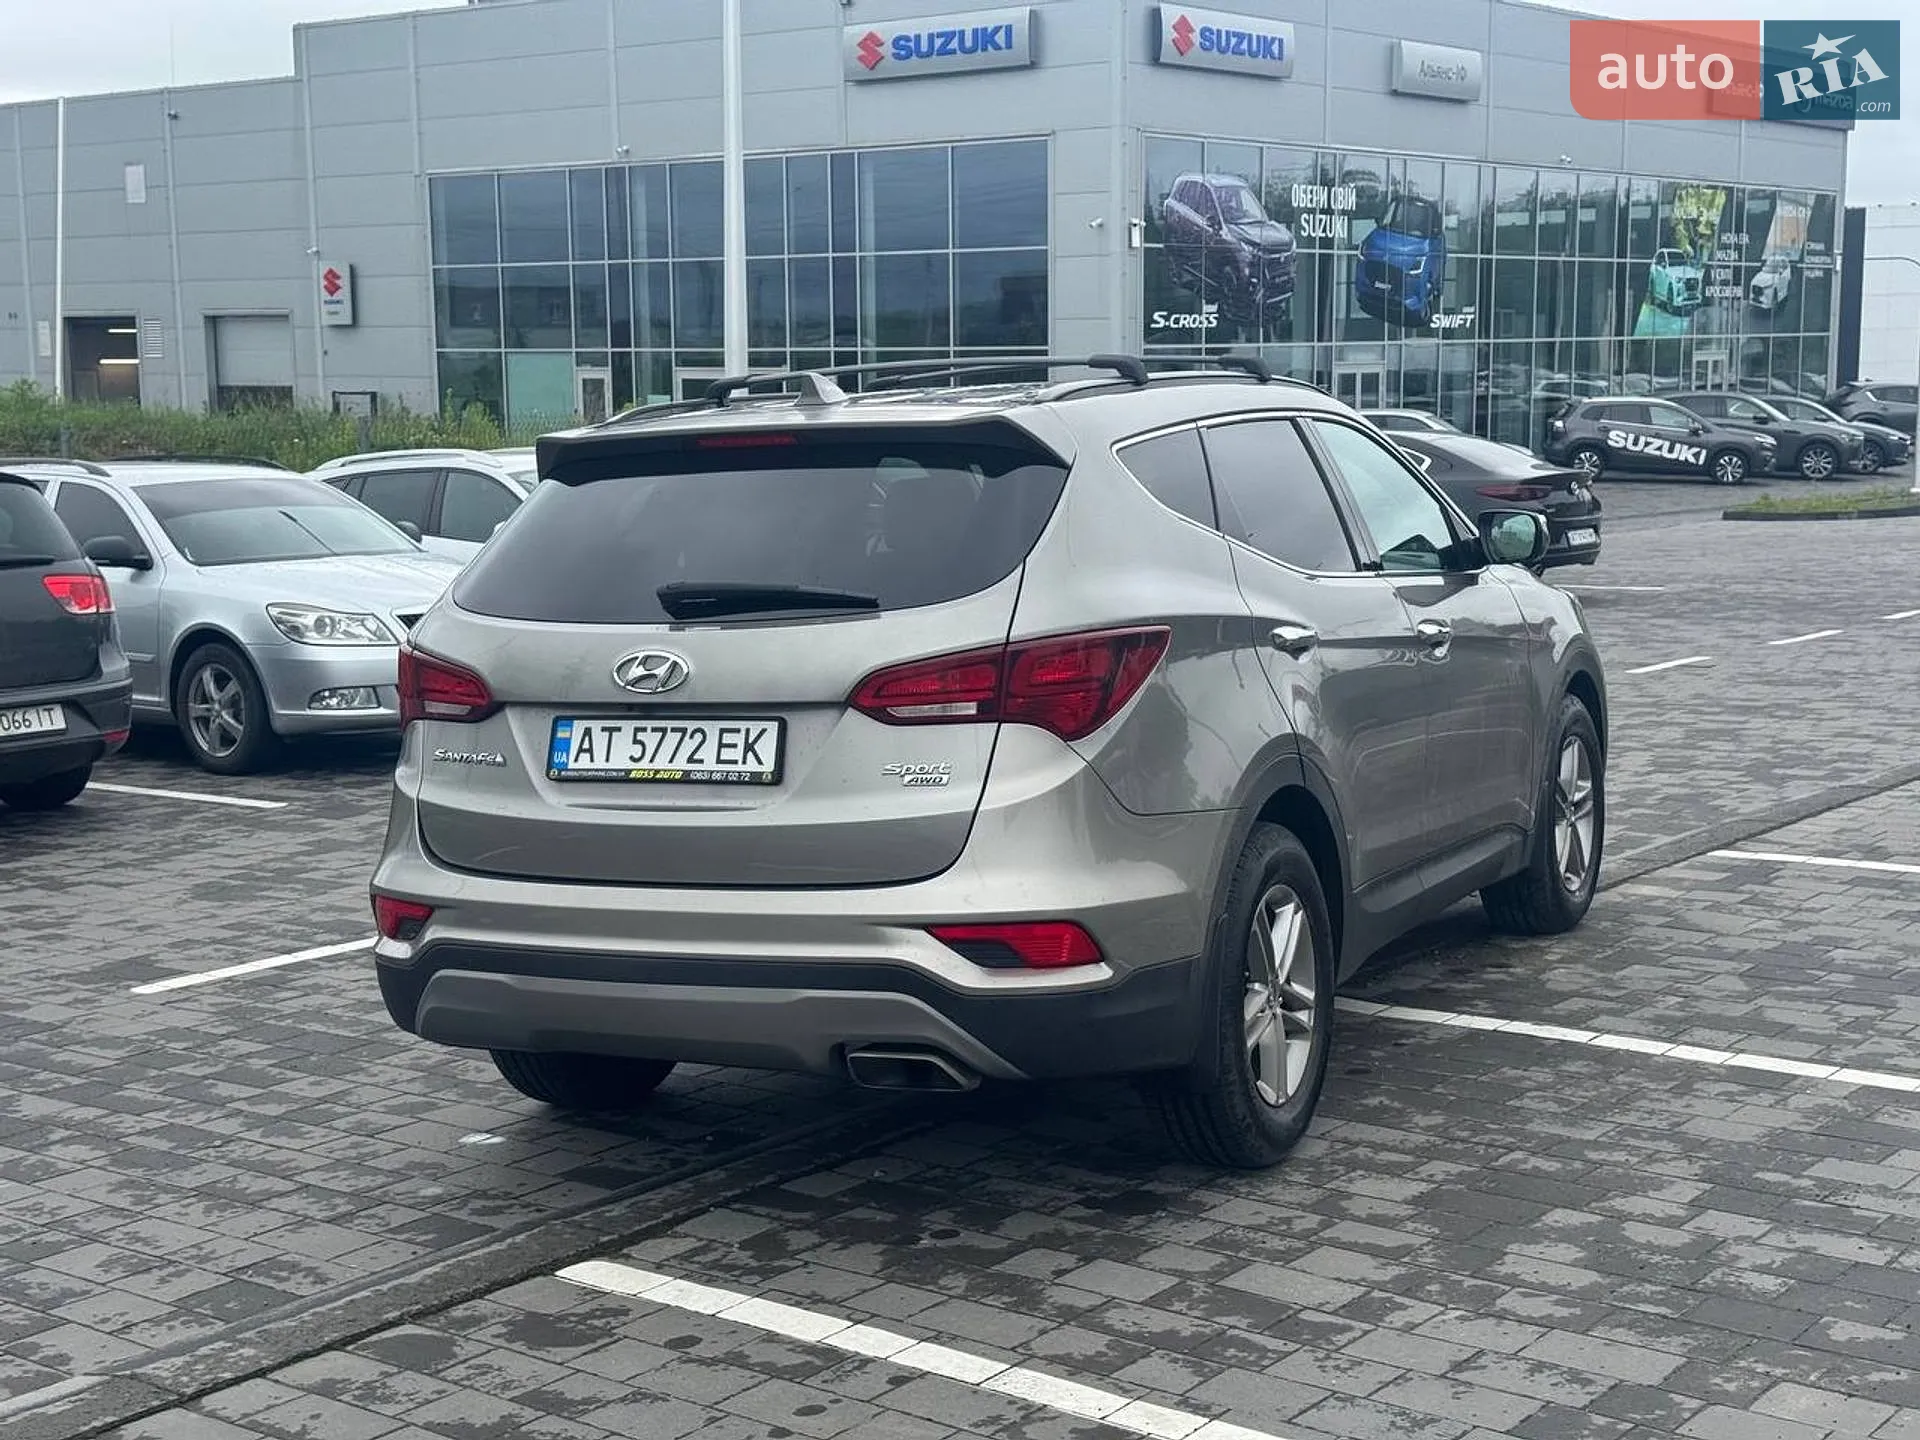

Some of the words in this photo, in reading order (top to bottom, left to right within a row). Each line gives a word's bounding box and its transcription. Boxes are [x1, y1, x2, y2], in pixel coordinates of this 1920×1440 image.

[891, 24, 1013, 61] SUZUKI
[1199, 26, 1284, 61] SUZUKI
[1291, 184, 1328, 210] ОБЕРИ
[1330, 182, 1356, 211] СВІЙ
[1300, 213, 1348, 239] SUZUKI
[1430, 314, 1475, 328] SWIFT
[1606, 430, 1707, 465] SUZUKI
[553, 751, 568, 763] UA
[573, 726, 622, 763] AT
[628, 726, 708, 764] 5772
[716, 727, 768, 766] EK
[881, 762, 950, 777] Sport
